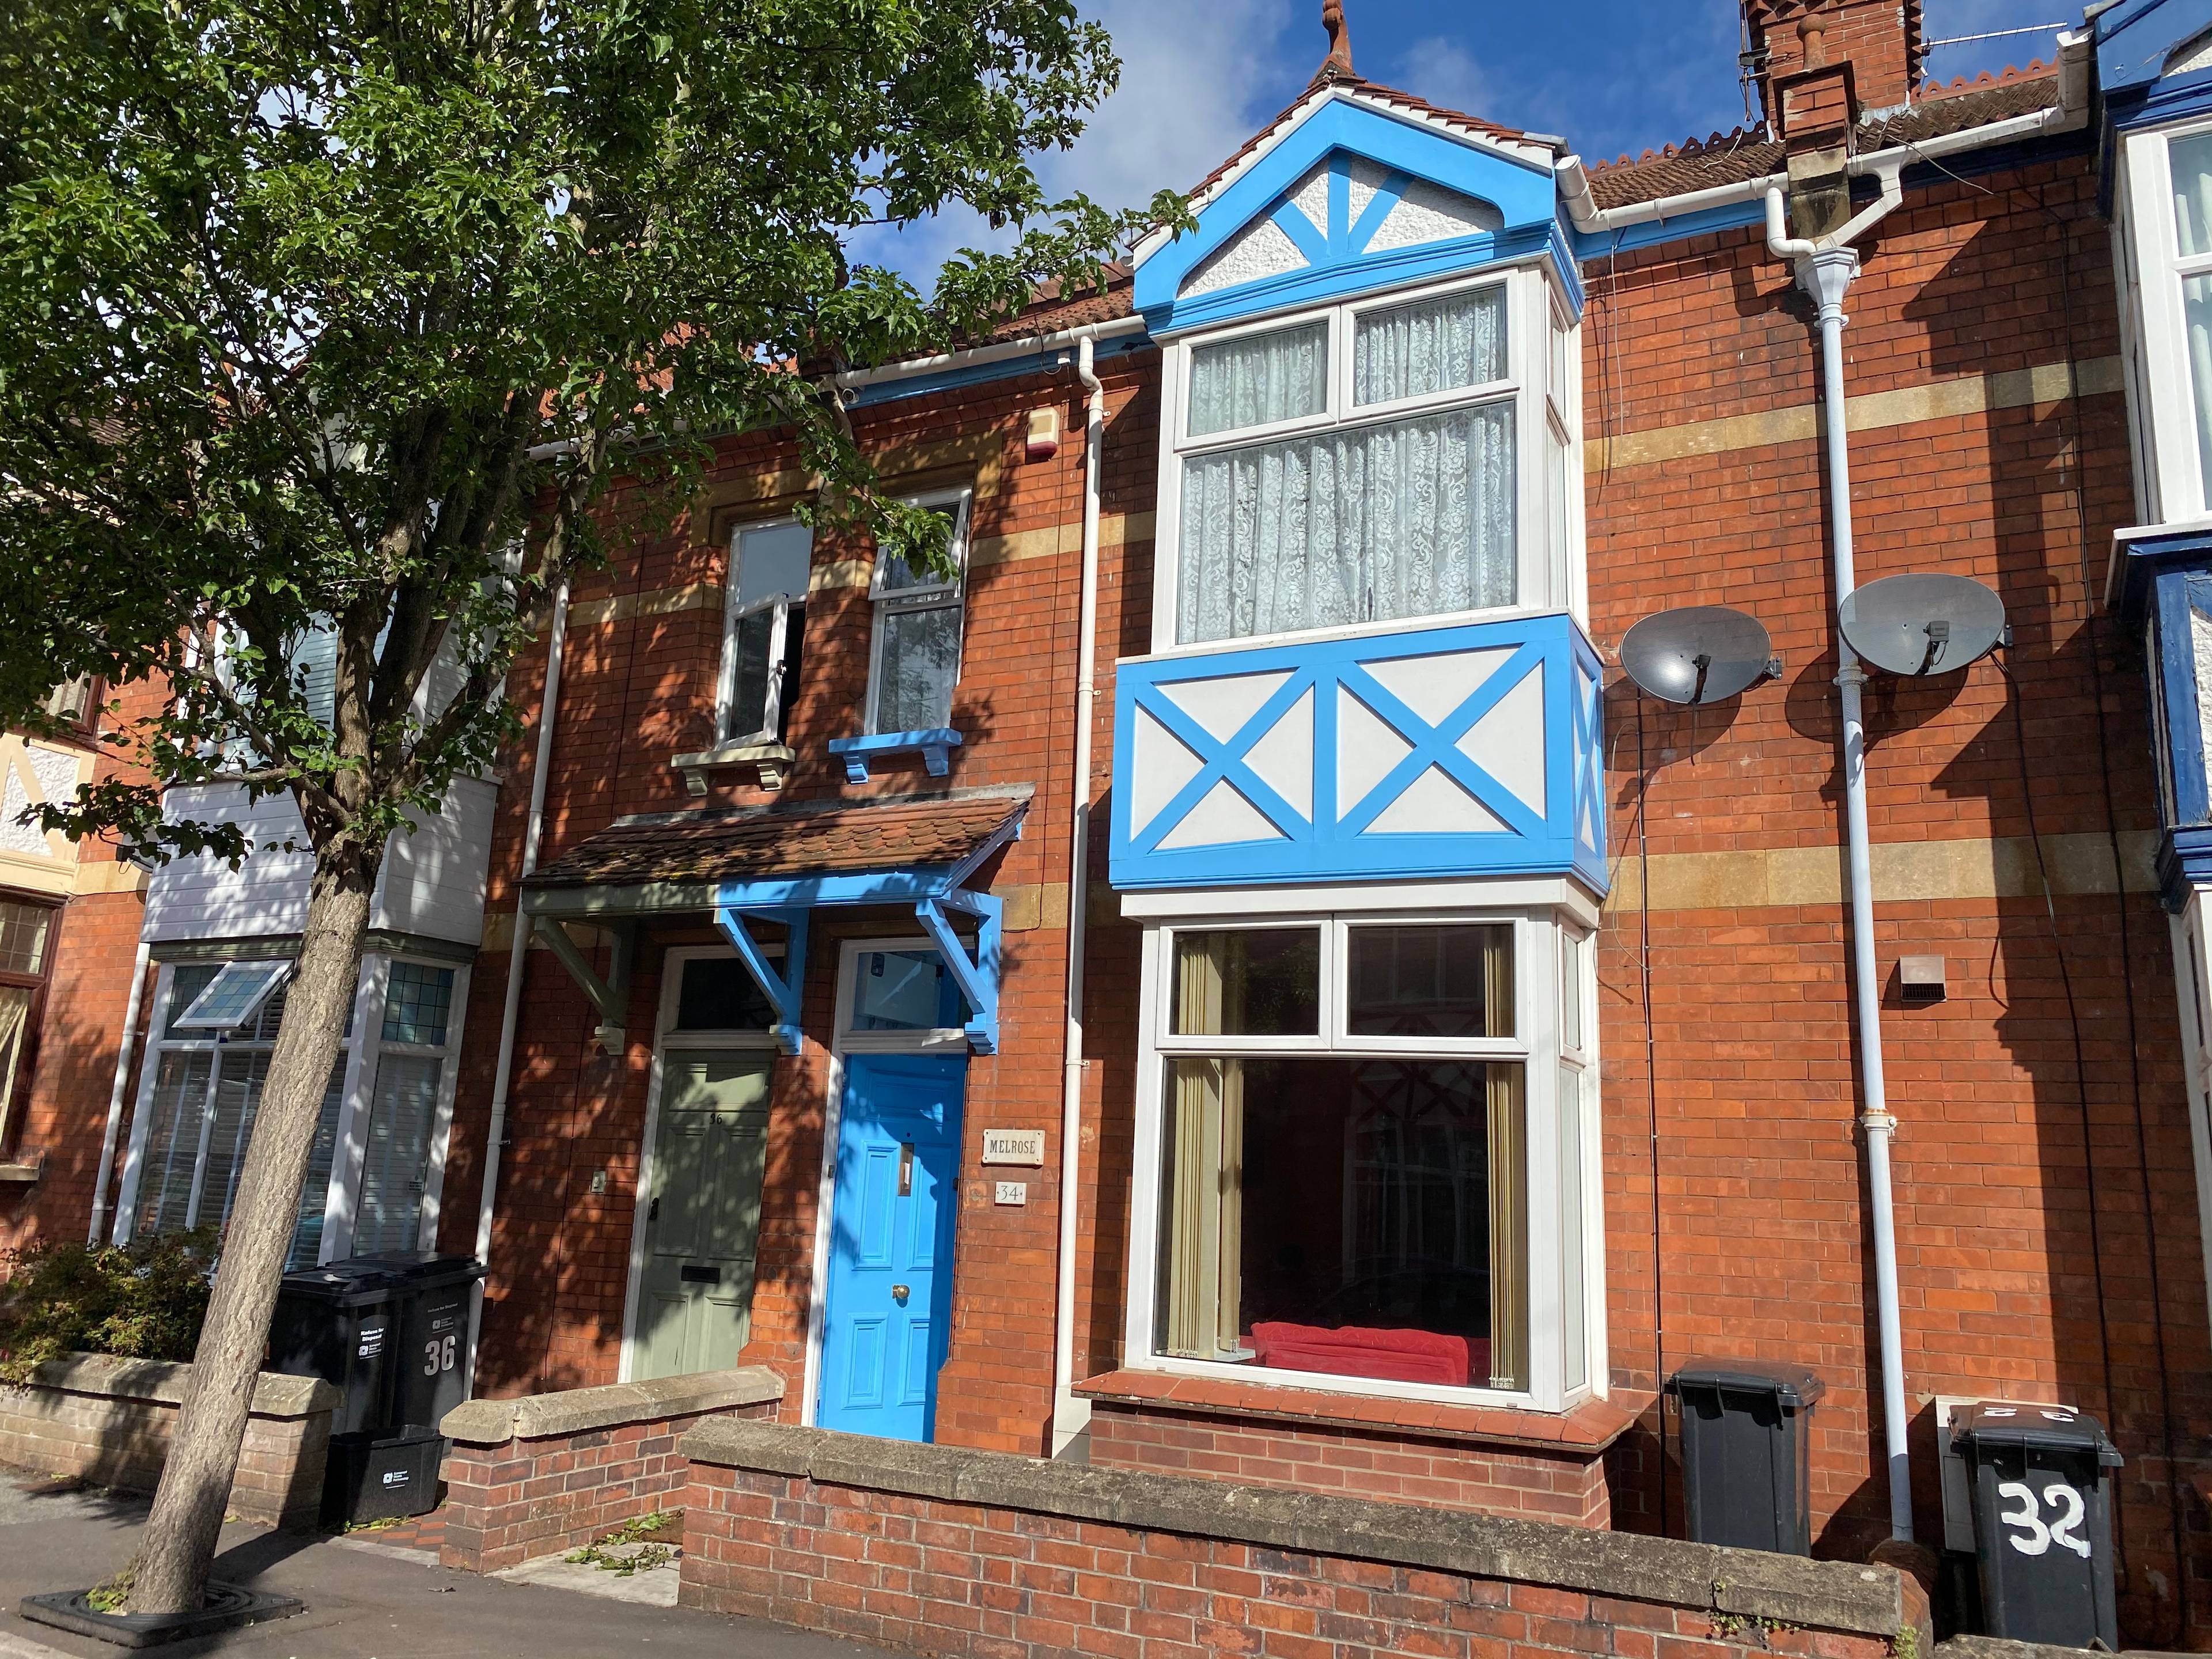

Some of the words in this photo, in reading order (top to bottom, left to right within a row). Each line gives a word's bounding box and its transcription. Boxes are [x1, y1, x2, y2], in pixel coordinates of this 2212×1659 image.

[710, 1113, 722, 1125] 36
[990, 1139, 1035, 1154] MELROSE
[1001, 1185, 1018, 1200] 34
[424, 1335, 456, 1376] 36
[1998, 1482, 2092, 1558] 32
